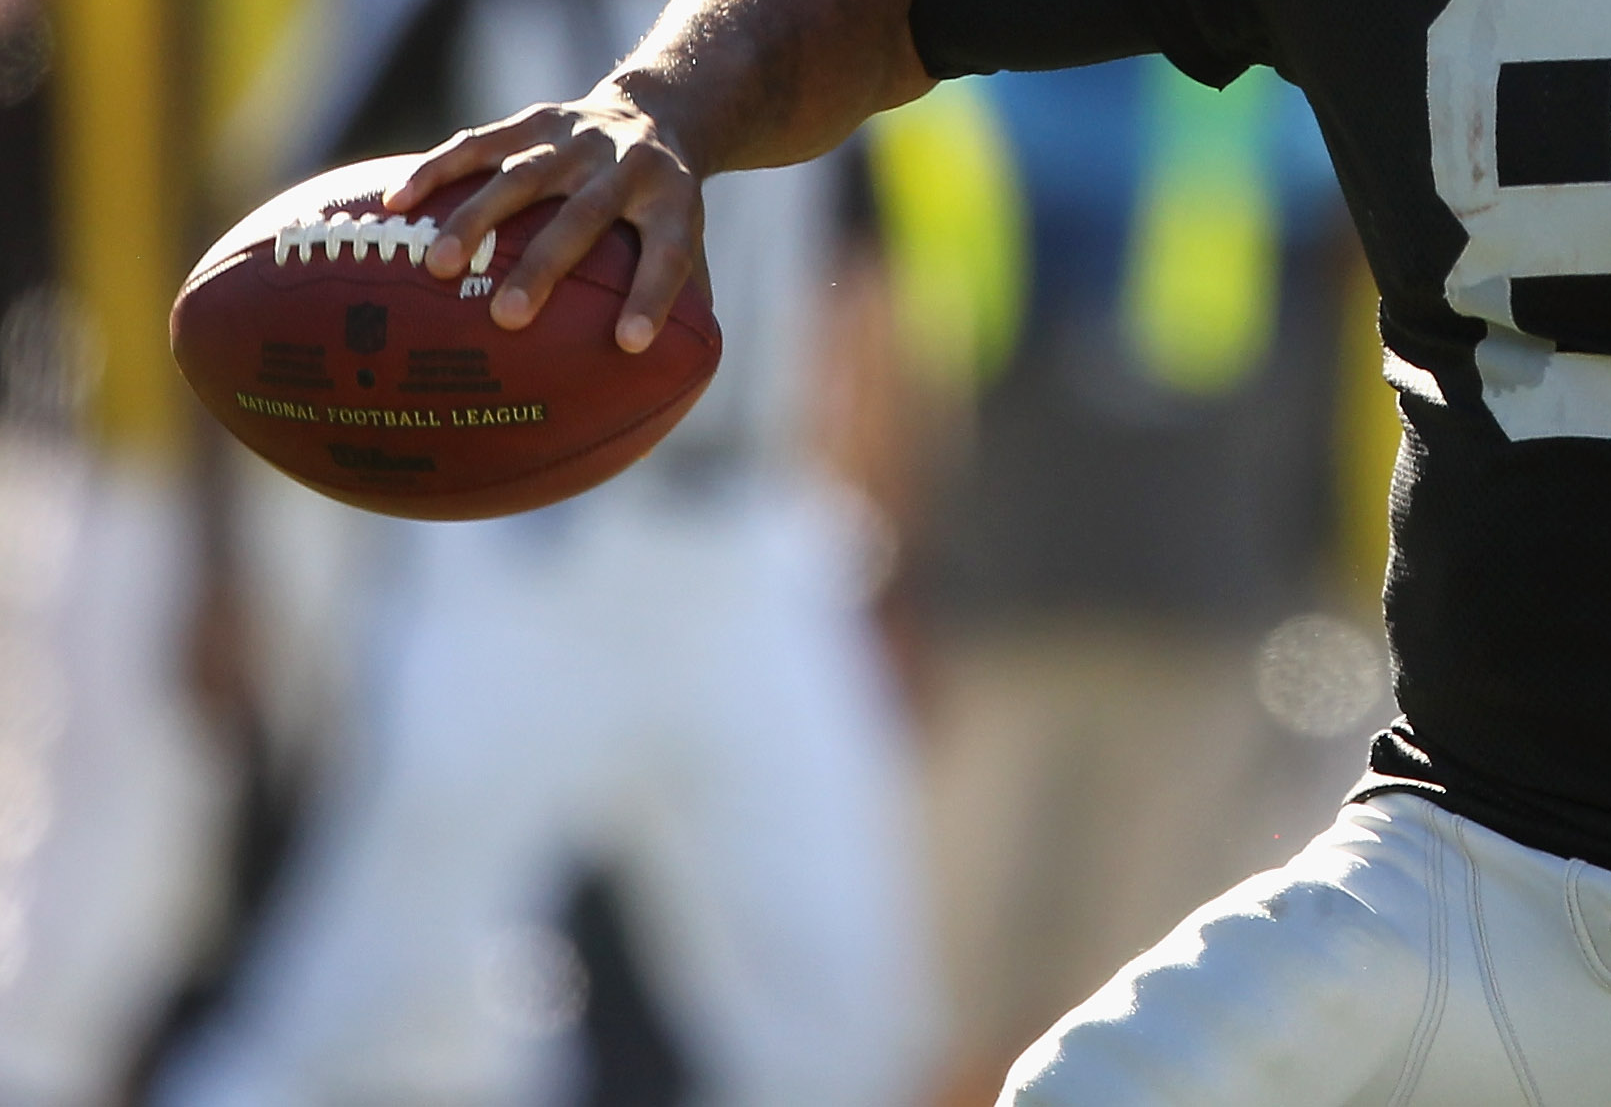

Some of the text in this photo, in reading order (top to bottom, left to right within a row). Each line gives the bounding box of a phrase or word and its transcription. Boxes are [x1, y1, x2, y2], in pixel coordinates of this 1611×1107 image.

[236, 391, 544, 427] NATIONAL FOOTBALL LEAGUE
